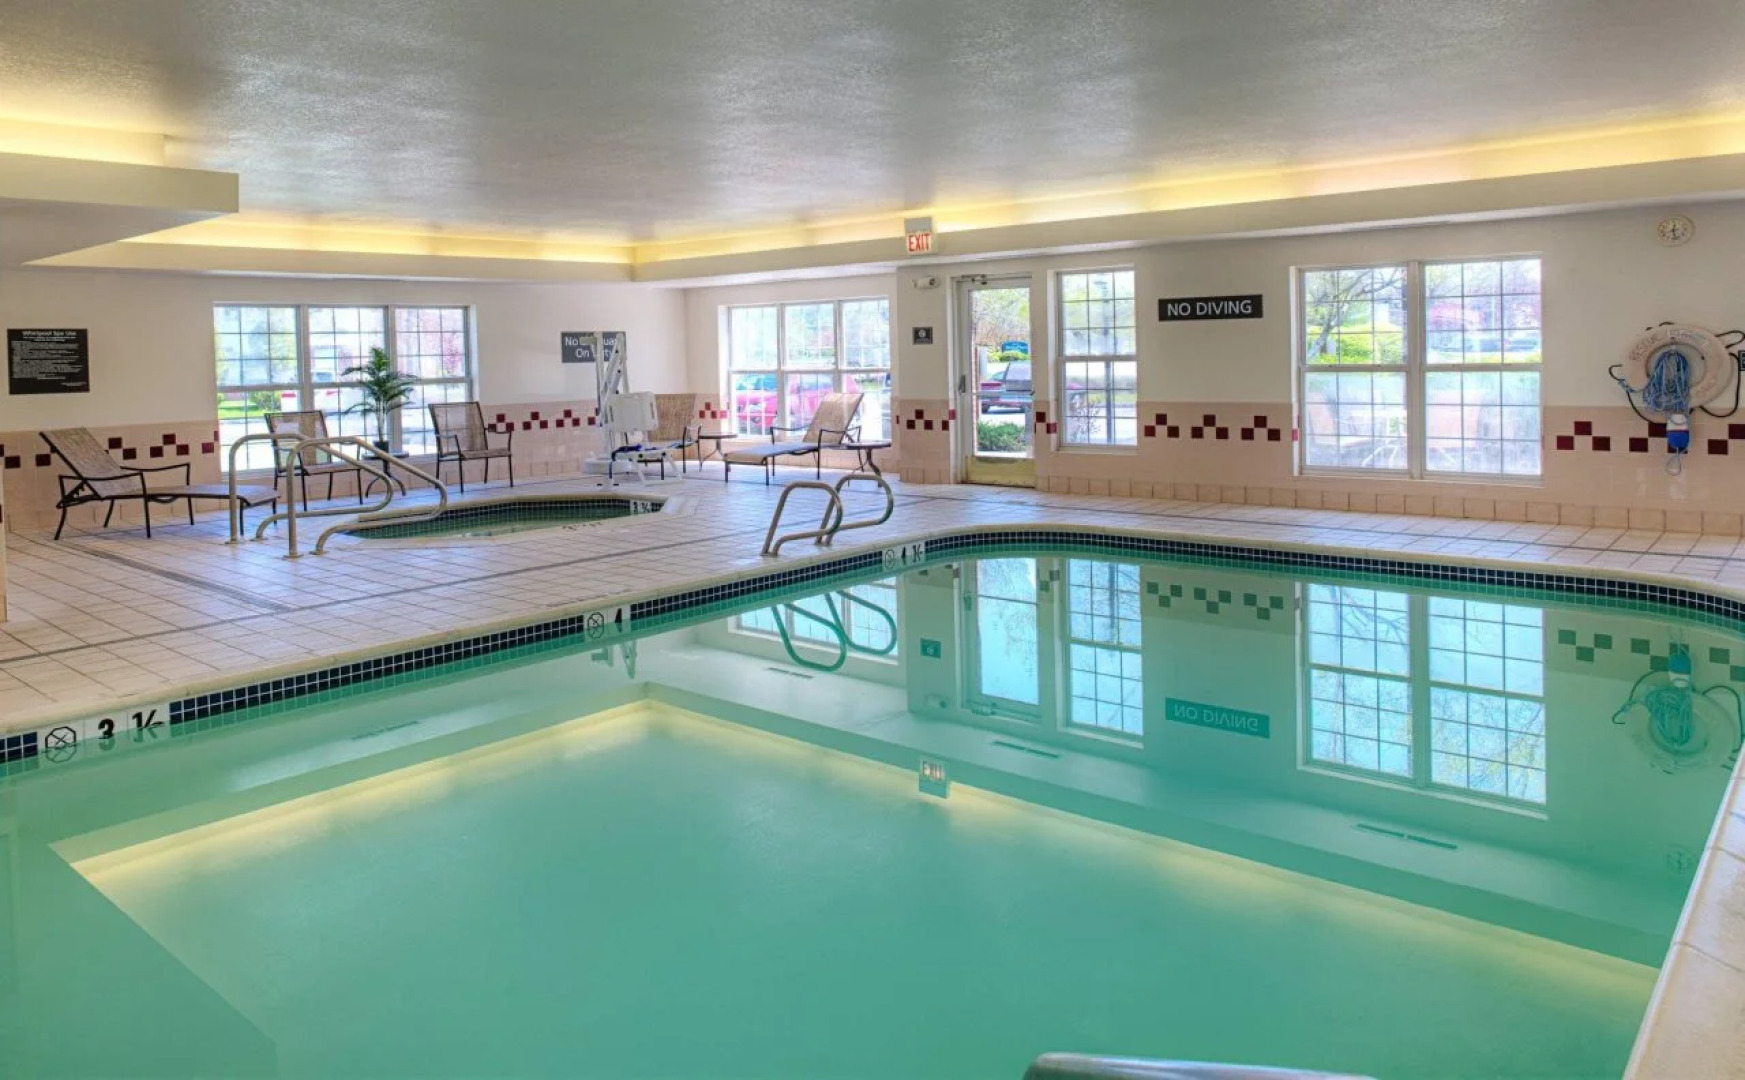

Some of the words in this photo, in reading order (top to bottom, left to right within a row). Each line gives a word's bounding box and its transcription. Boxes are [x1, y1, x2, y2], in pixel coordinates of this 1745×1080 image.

[908, 232, 930, 252] EXIT
[1167, 302, 1191, 317] NO
[1196, 299, 1252, 316] DIVING
[565, 336, 579, 346] No
[575, 348, 590, 358] On
